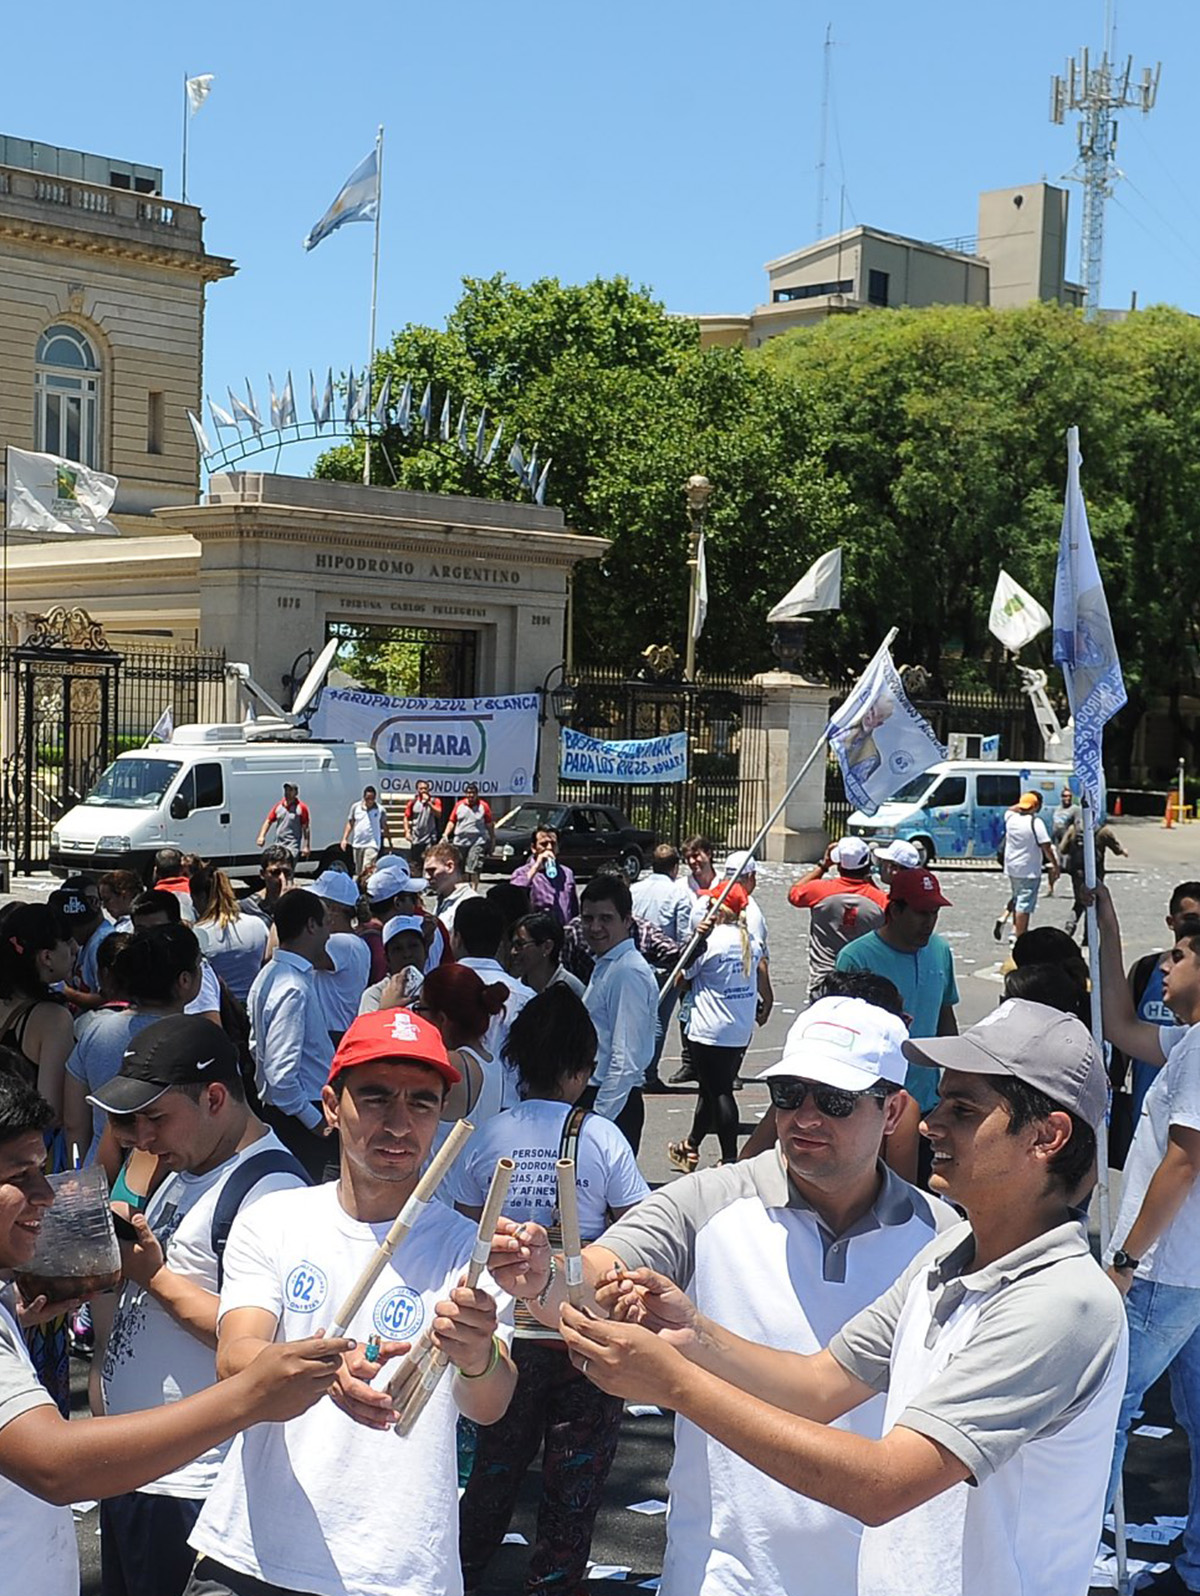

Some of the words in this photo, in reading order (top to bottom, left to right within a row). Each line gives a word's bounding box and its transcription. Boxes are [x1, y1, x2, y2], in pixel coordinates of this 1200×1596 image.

[315, 554, 414, 575] HIPODROMO
[429, 565, 521, 583] ARGENTINO
[390, 602, 426, 613] CARLOS
[432, 605, 486, 617] PELLEGRINI
[430, 699, 467, 711] AZUL
[472, 699, 481, 711] Y
[485, 696, 538, 710] BLANCA
[389, 732, 472, 756] APHARA
[563, 752, 595, 773] PARA
[596, 755, 615, 774] LOS
[381, 778, 412, 791] OGA
[1149, 1004, 1170, 1017] HE
[512, 1149, 558, 1158] PERSONA
[514, 1161, 556, 1171] PODROM
[511, 1188, 517, 1196] Y
[520, 1187, 556, 1196] AFINES
[510, 1200, 521, 1208] de
[524, 1199, 532, 1207] la
[293, 1271, 315, 1301] 62
[383, 1299, 414, 1329] CGT
